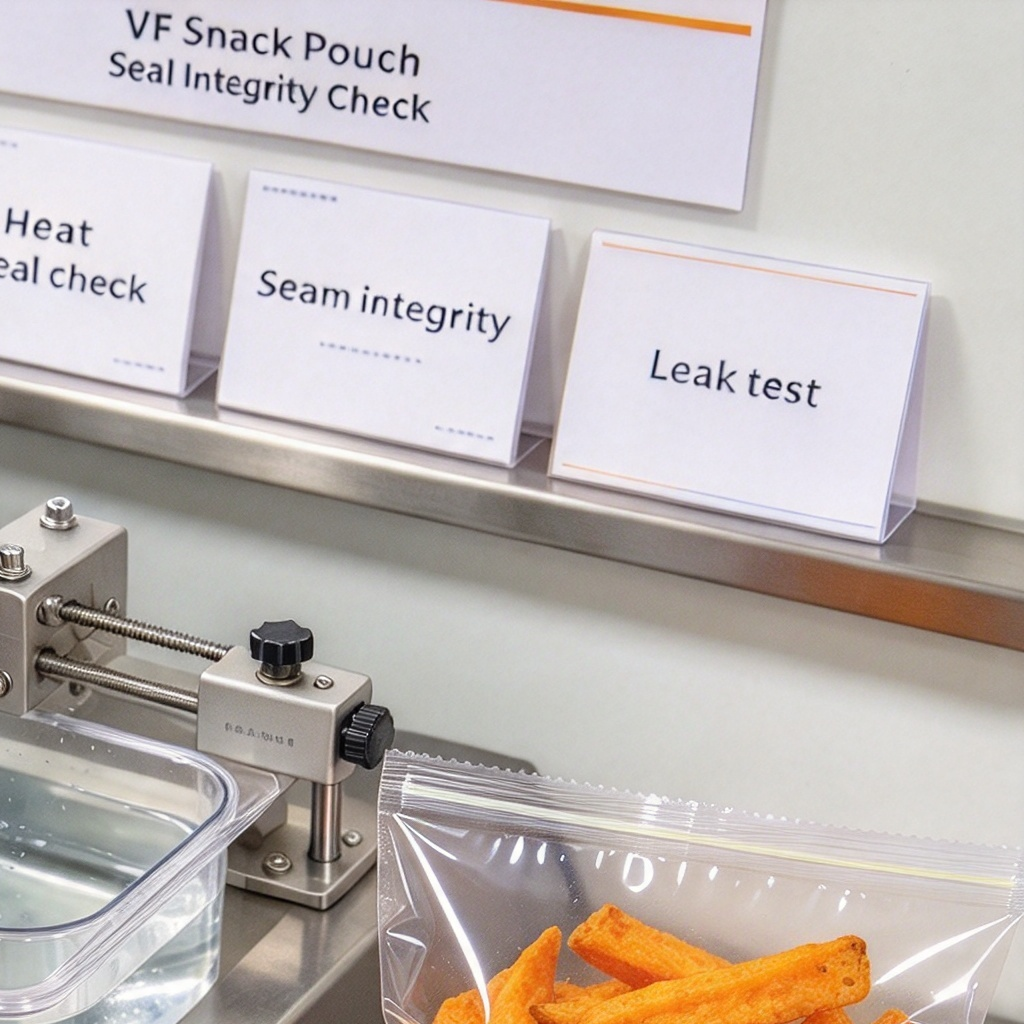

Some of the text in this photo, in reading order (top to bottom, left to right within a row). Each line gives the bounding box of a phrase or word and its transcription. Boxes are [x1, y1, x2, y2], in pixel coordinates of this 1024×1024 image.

[125, 9, 420, 77] VF Snack Pouch
[109, 51, 431, 124] Seal Integrity Check
[5, 207, 93, 247] Heat
[49, 263, 146, 303] check
[257, 270, 511, 343] Seam integrity
[650, 349, 822, 408] Leak test
